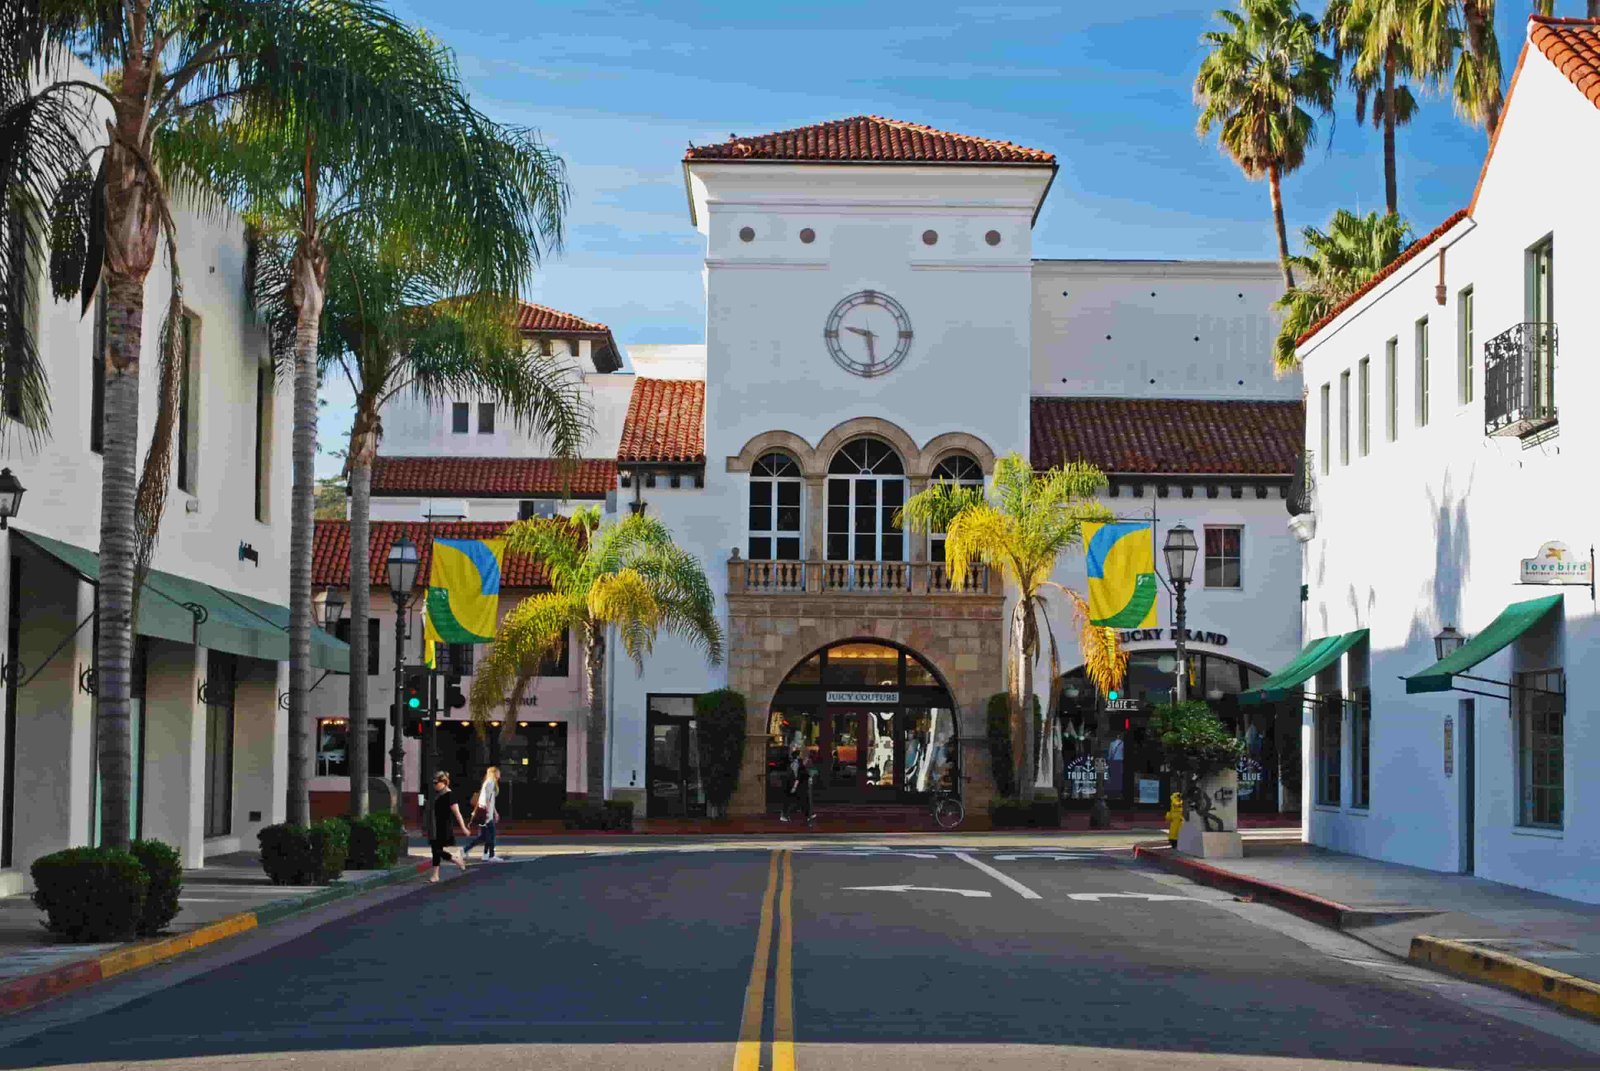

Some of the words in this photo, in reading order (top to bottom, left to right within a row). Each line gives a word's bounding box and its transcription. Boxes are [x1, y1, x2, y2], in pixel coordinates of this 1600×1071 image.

[1525, 562, 1587, 571] lovebird
[1120, 628, 1164, 643] UCKY
[827, 692, 853, 701] JUICY
[855, 692, 898, 702] COUTURE
[1107, 700, 1128, 709] STATE
[1242, 772, 1262, 781] BLUE
